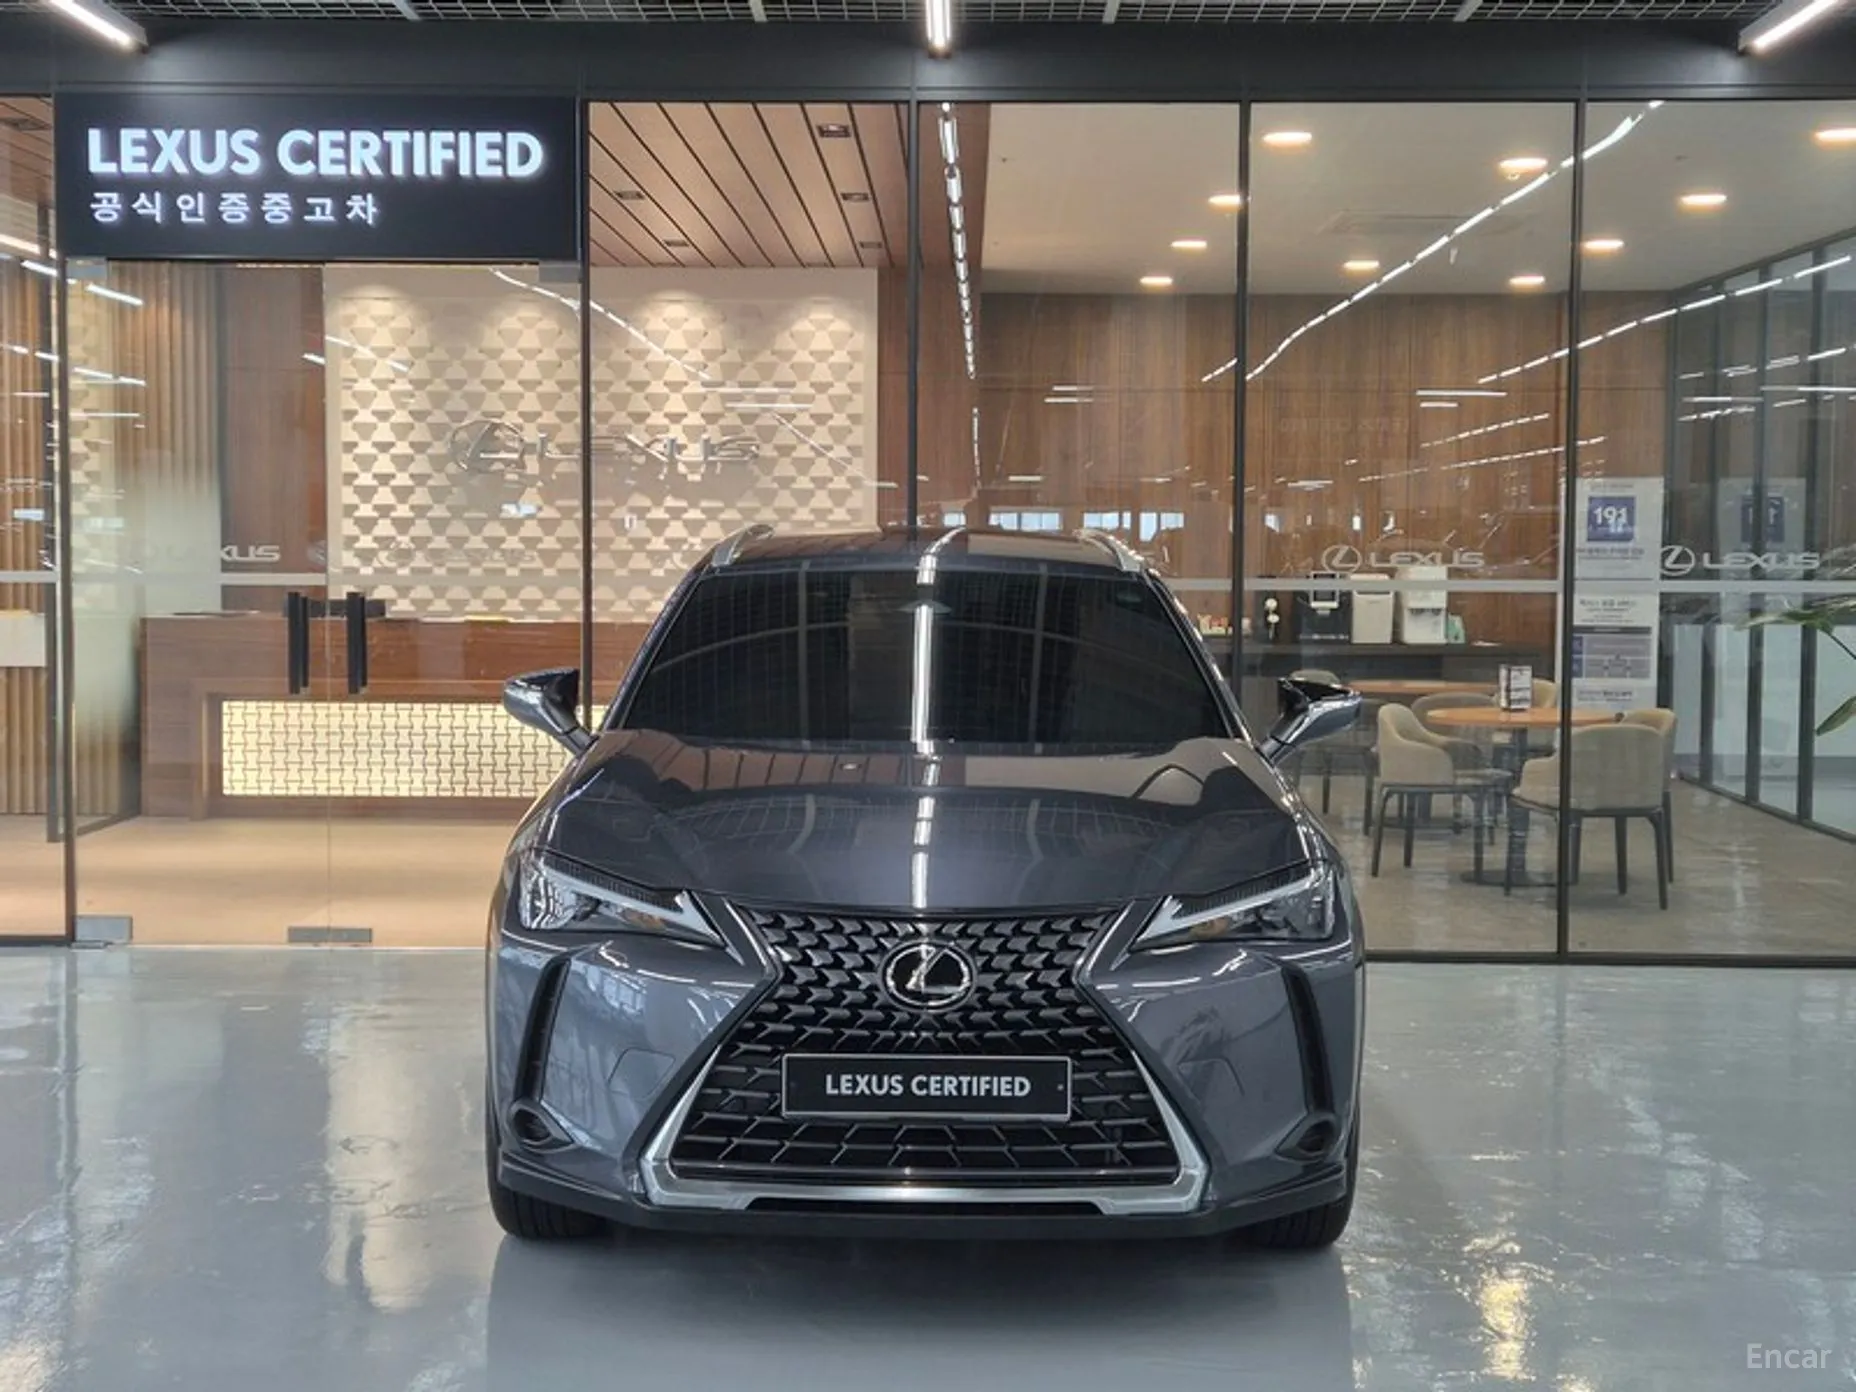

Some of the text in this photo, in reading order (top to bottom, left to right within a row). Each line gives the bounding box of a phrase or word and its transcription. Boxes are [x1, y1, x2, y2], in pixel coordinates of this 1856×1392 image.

[88, 128, 544, 178] LEXUS CERTIFIED
[90, 190, 378, 224] 공식인증중고차
[1370, 551, 1486, 568] LEXUS
[1702, 552, 1821, 570] LEXUS
[825, 1073, 1031, 1098] LEXUS CERTIFIED
